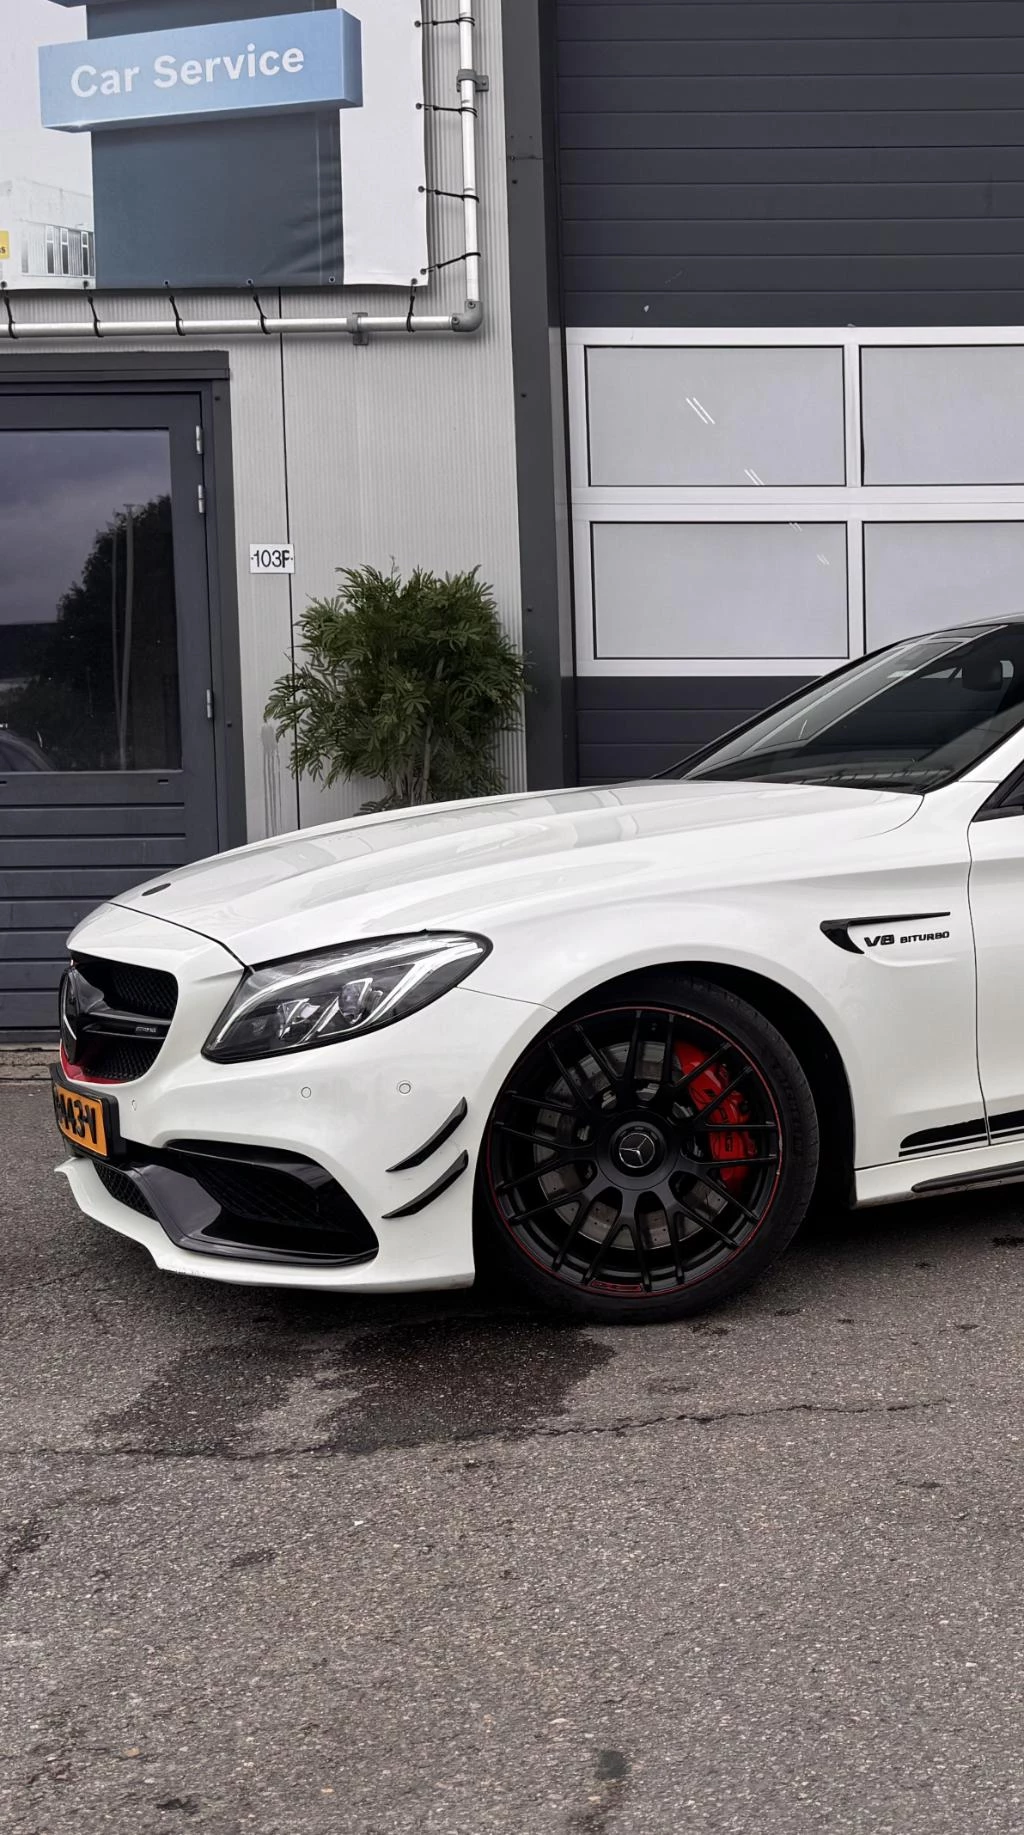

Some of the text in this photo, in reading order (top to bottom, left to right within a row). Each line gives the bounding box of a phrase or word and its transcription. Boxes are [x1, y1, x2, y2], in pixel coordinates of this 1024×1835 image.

[70, 43, 305, 98] Car Service
[253, 549, 290, 569] 103F
[863, 931, 950, 947] V8 BITURBO
